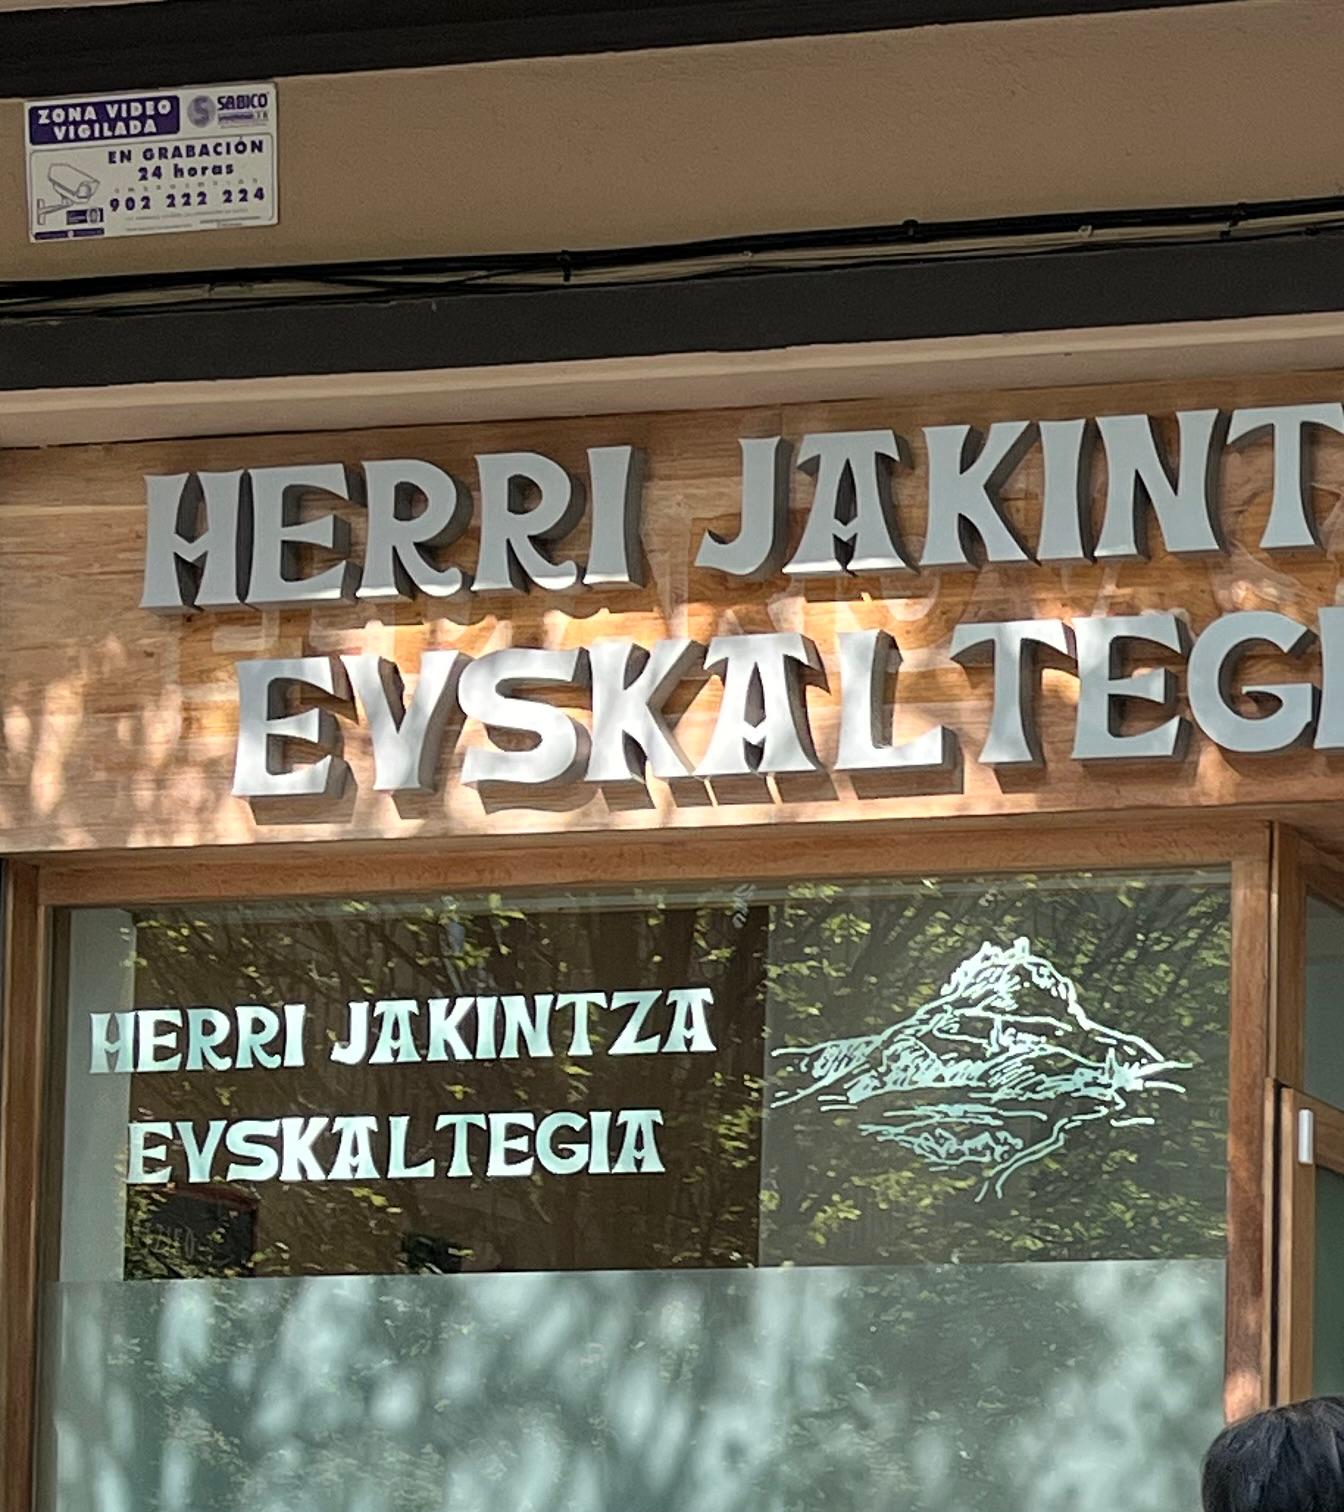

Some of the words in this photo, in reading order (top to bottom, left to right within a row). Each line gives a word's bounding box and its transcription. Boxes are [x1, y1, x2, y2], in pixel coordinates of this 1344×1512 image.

[37, 105, 97, 125] ZONA
[105, 99, 172, 119] VIDEO
[53, 118, 157, 141] VIGILADA
[108, 150, 132, 164] EN
[142, 136, 264, 161] GRABACIÓN
[138, 166, 162, 181] 24
[173, 163, 235, 178] horas
[110, 196, 151, 212] 902
[166, 191, 208, 208] 222
[222, 187, 265, 204] 224
[141, 445, 646, 609] HERRI
[88, 1005, 306, 1074] HERRI
[331, 988, 717, 1067] JAKINTZA
